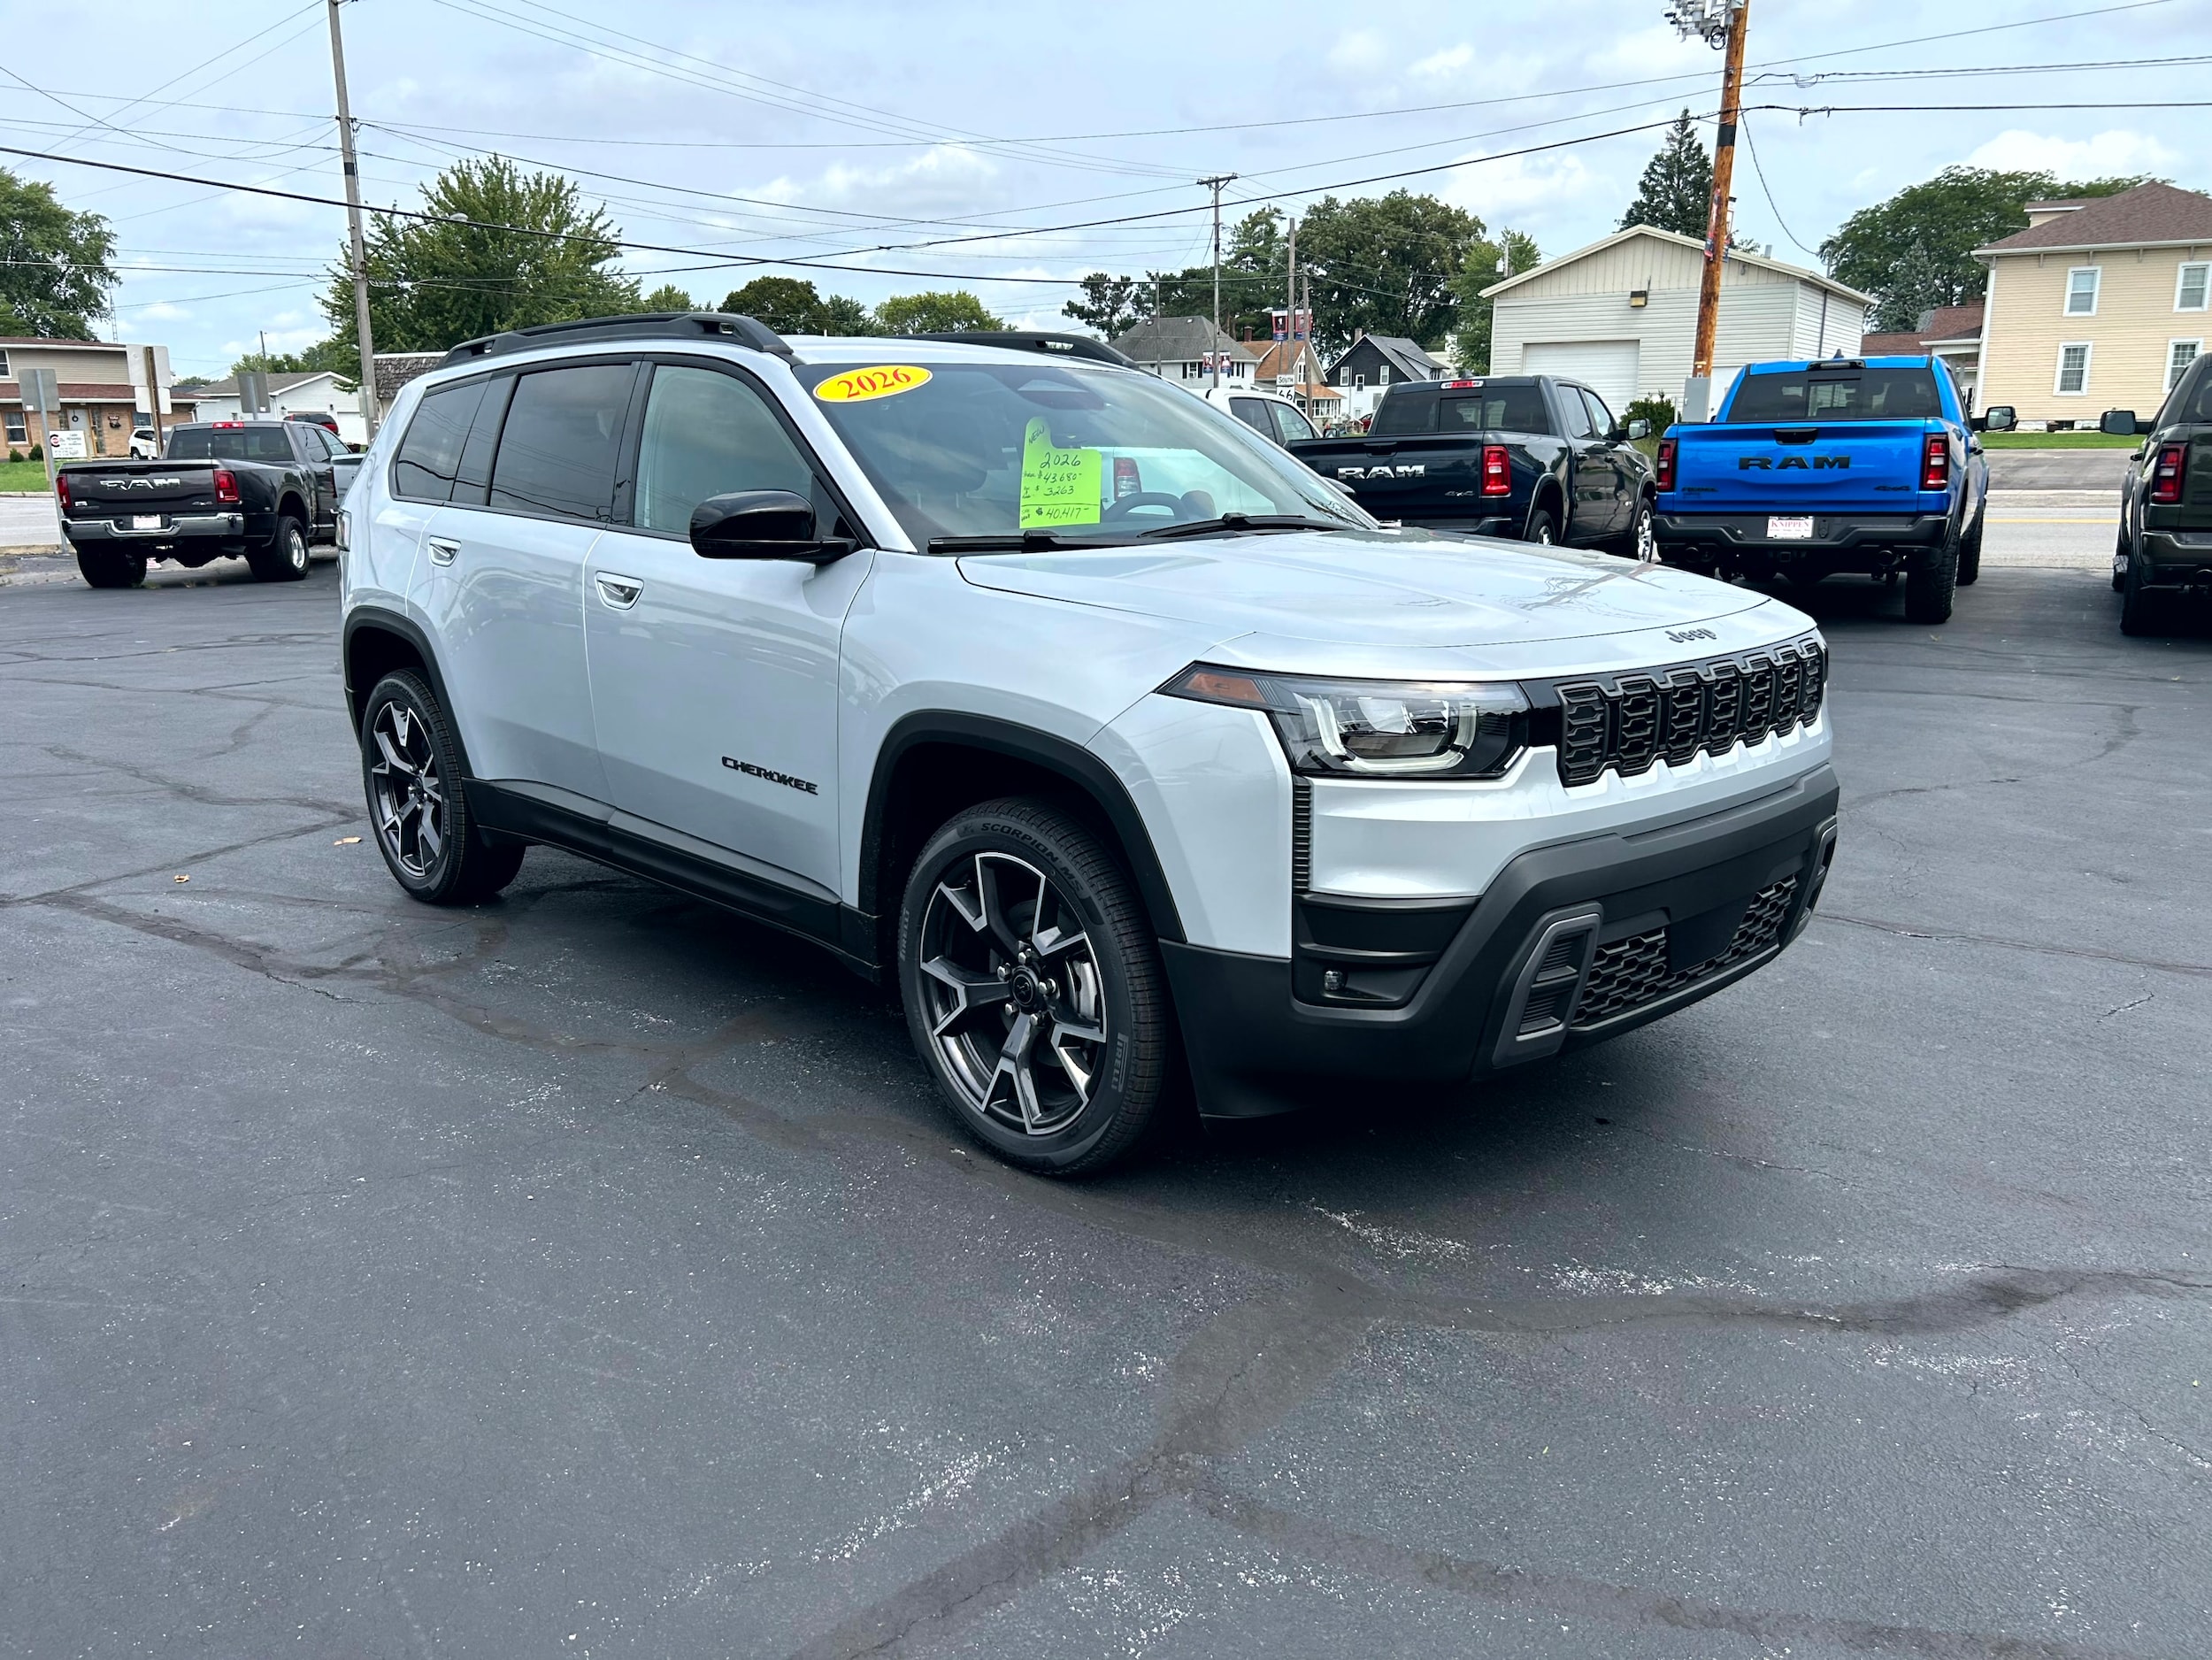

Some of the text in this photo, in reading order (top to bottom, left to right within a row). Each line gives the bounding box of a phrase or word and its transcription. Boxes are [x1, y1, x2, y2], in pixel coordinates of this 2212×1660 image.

[837, 368, 910, 398] 2026
[1028, 426, 1044, 445] NEW
[1041, 451, 1080, 468] 2026
[1739, 457, 1850, 470] RAM
[1337, 465, 1425, 480] RAM
[100, 479, 180, 490] RAM
[1664, 627, 1717, 642] Jeep
[721, 756, 818, 795] CHEROKEE
[981, 823, 1058, 863] SCORPION
[1110, 1032, 1129, 1093] PIRELLI
